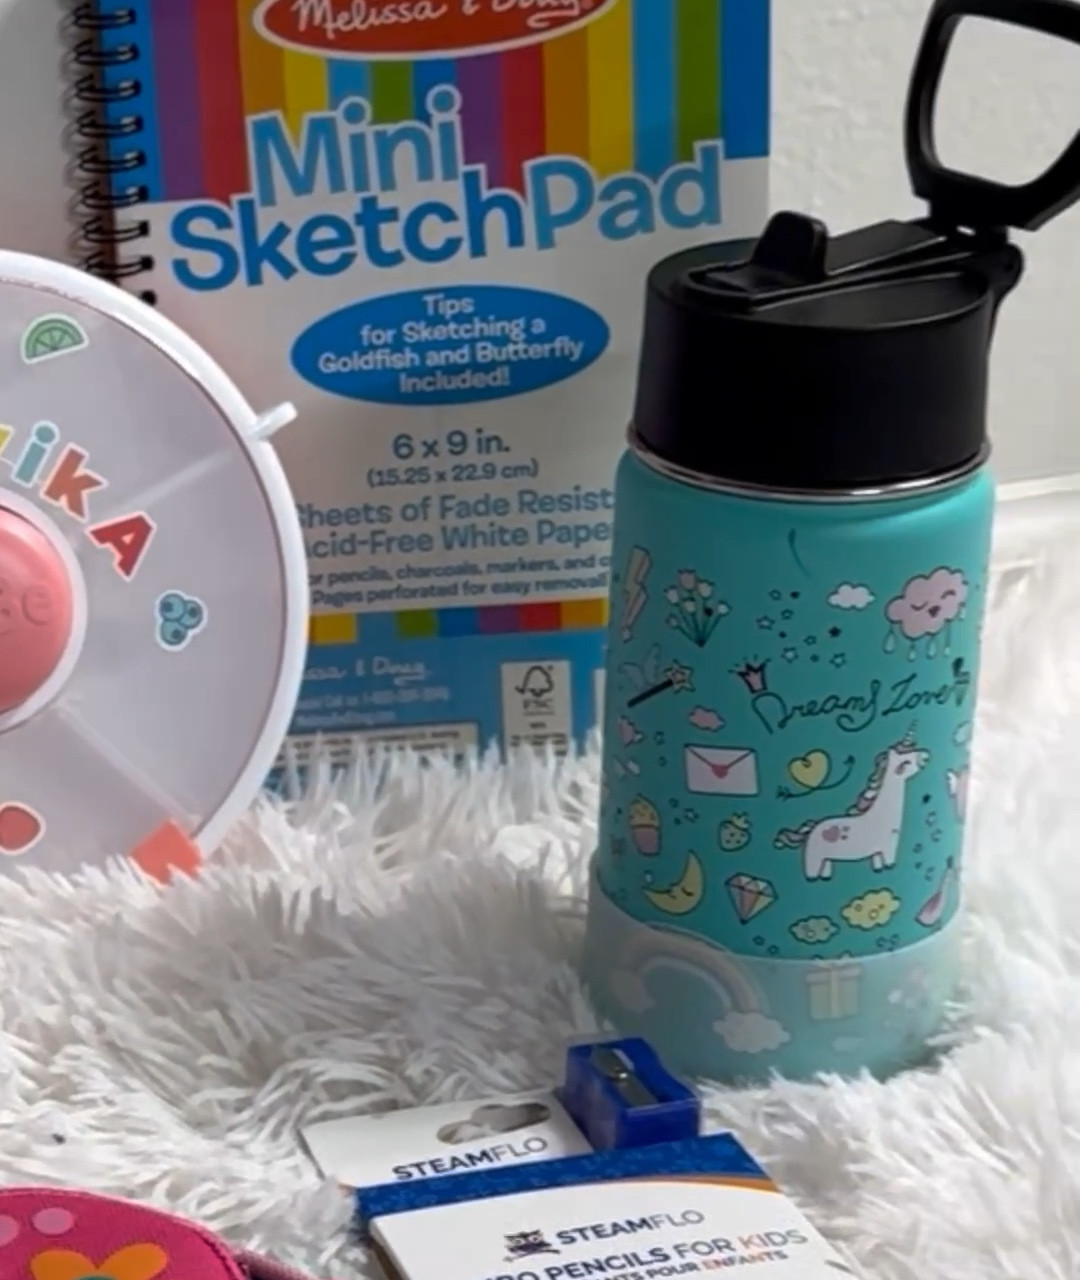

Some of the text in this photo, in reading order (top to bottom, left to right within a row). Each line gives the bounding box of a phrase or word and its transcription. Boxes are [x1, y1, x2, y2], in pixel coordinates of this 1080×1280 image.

[249, 86, 461, 207] Mini
[170, 144, 721, 292] SketchPad
[423, 294, 474, 318] Tips
[361, 315, 545, 346] for Sketching a
[319, 337, 584, 373] Goldfish and Butterfly
[399, 366, 511, 394] Included!
[393, 427, 511, 460] 6 x 9 in.
[435, 470, 447, 483] x
[452, 462, 498, 483] 22.9
[501, 458, 539, 480] cm)
[401, 496, 432, 521] of
[440, 492, 510, 519] Fade
[518, 485, 615, 513] Resist
[442, 522, 529, 550] White
[537, 519, 612, 549] Pape
[563, 554, 595, 570] and
[463, 579, 486, 596] for
[392, 1136, 548, 1181] STEAMFLO
[555, 1209, 705, 1247] STEAMFLO
[676, 1236, 736, 1259] FOR
[738, 1228, 809, 1251] KIDS
[646, 1261, 699, 1280] POUR
[702, 1249, 789, 1271] ENFANTS
